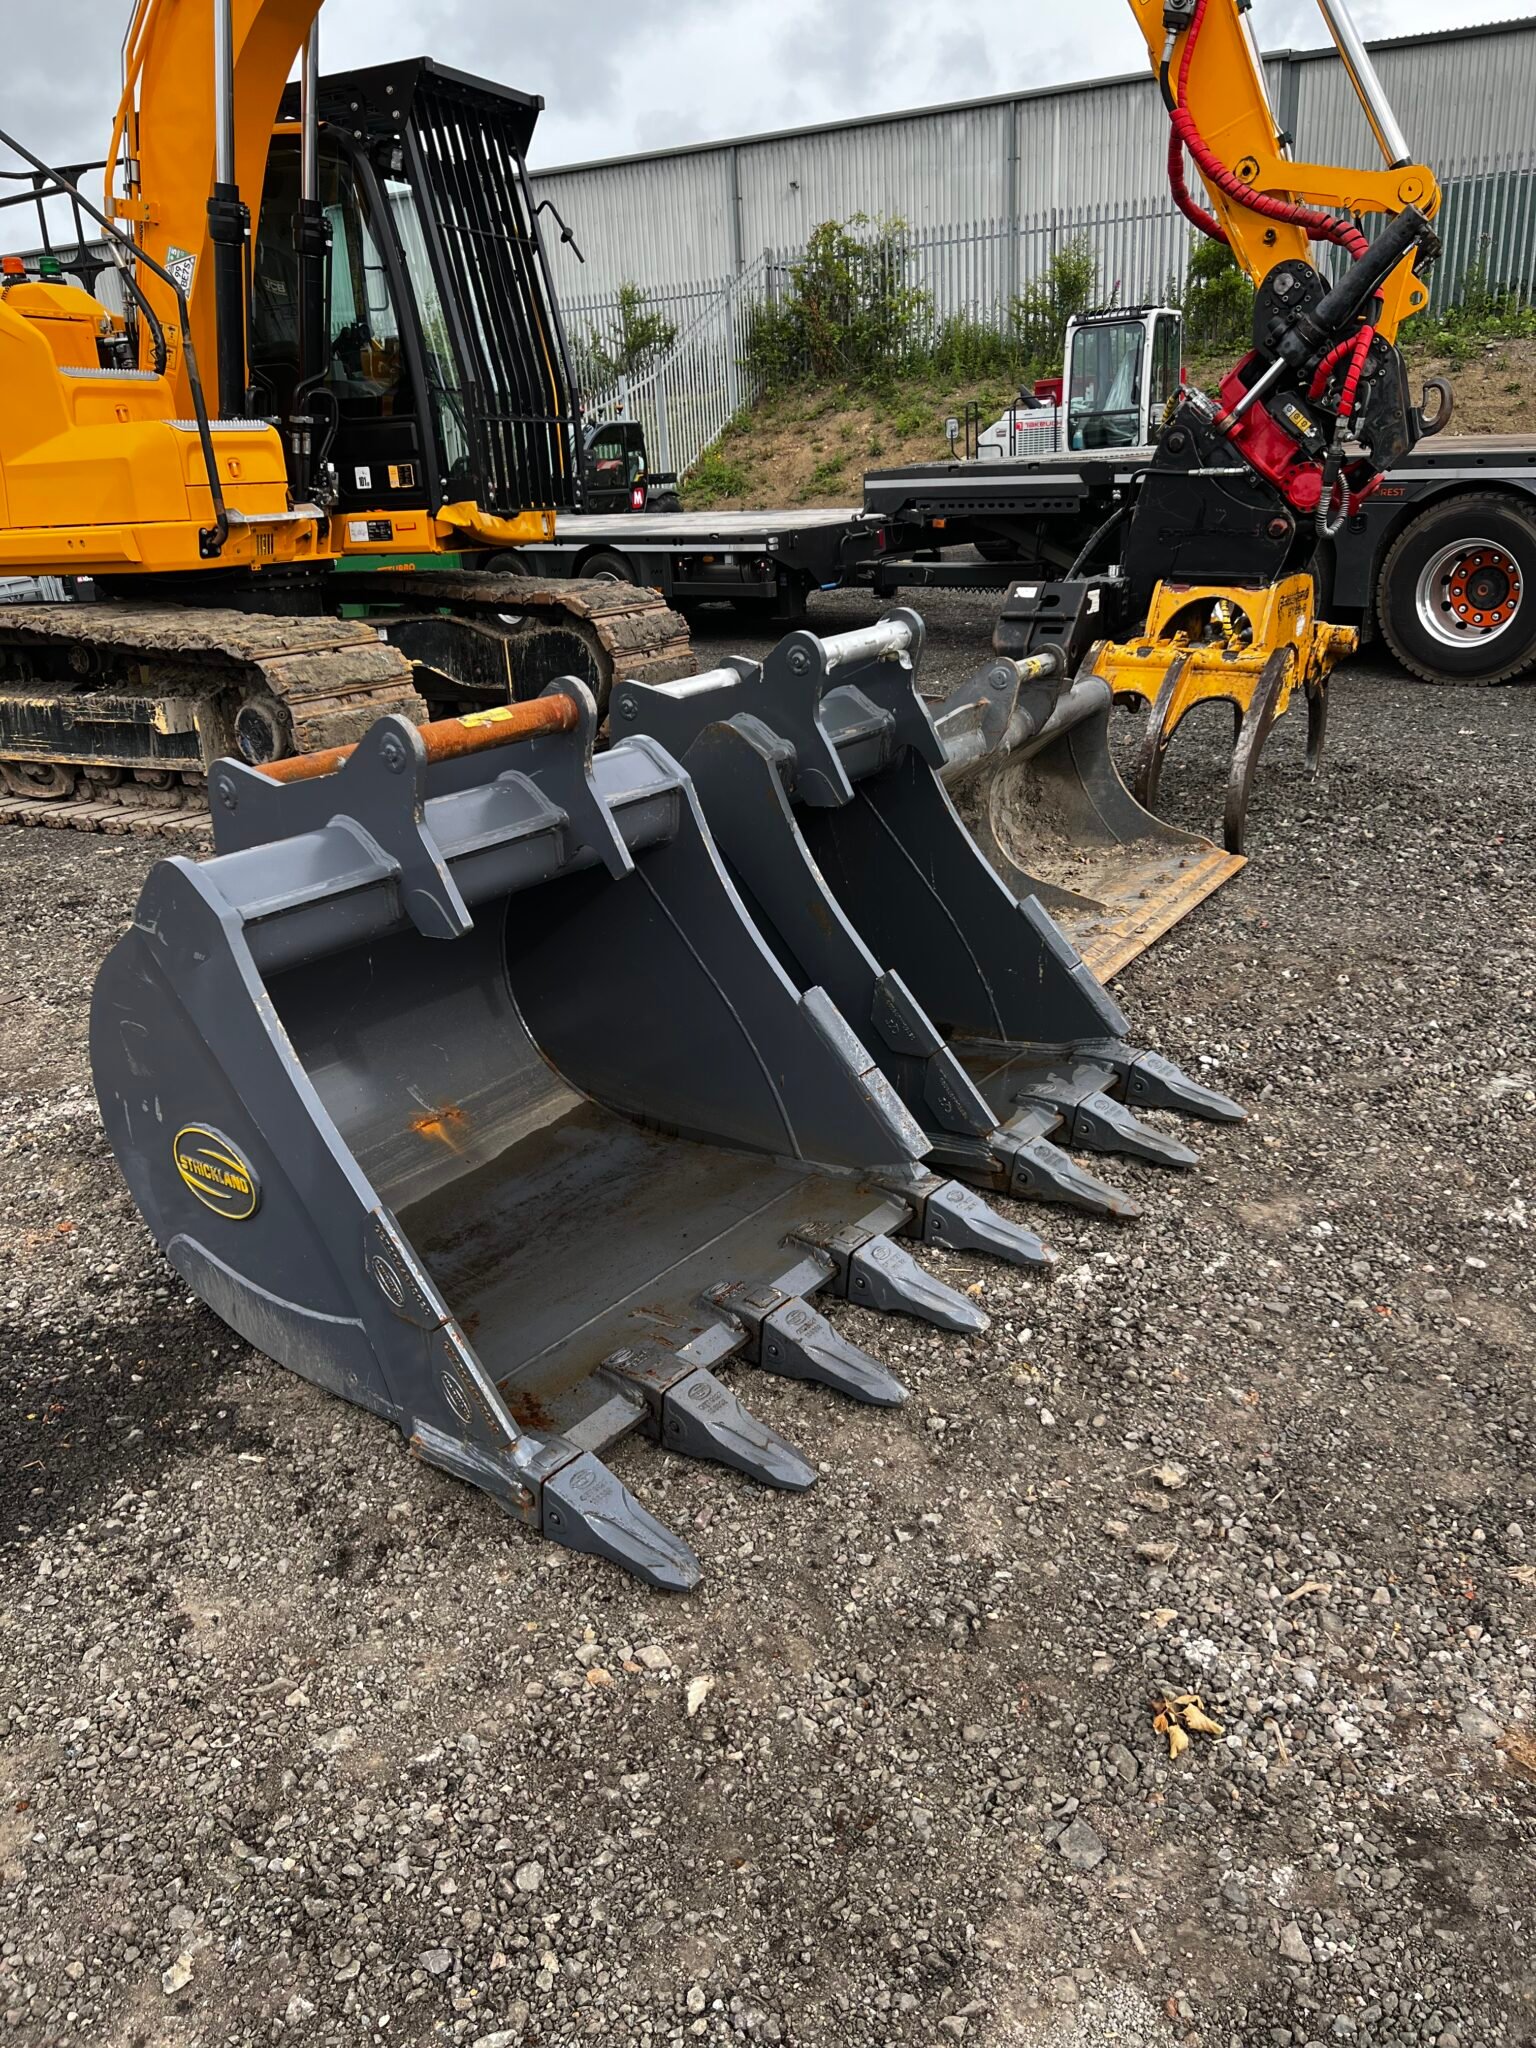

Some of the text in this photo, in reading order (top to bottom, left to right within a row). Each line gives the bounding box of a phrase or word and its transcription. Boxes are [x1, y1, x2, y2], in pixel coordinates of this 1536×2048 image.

[174, 265, 182, 278] 99
[1024, 420, 1063, 429] TAKEUCH
[1373, 487, 1406, 497] REST
[179, 1154, 249, 1194] STRICKLAND
